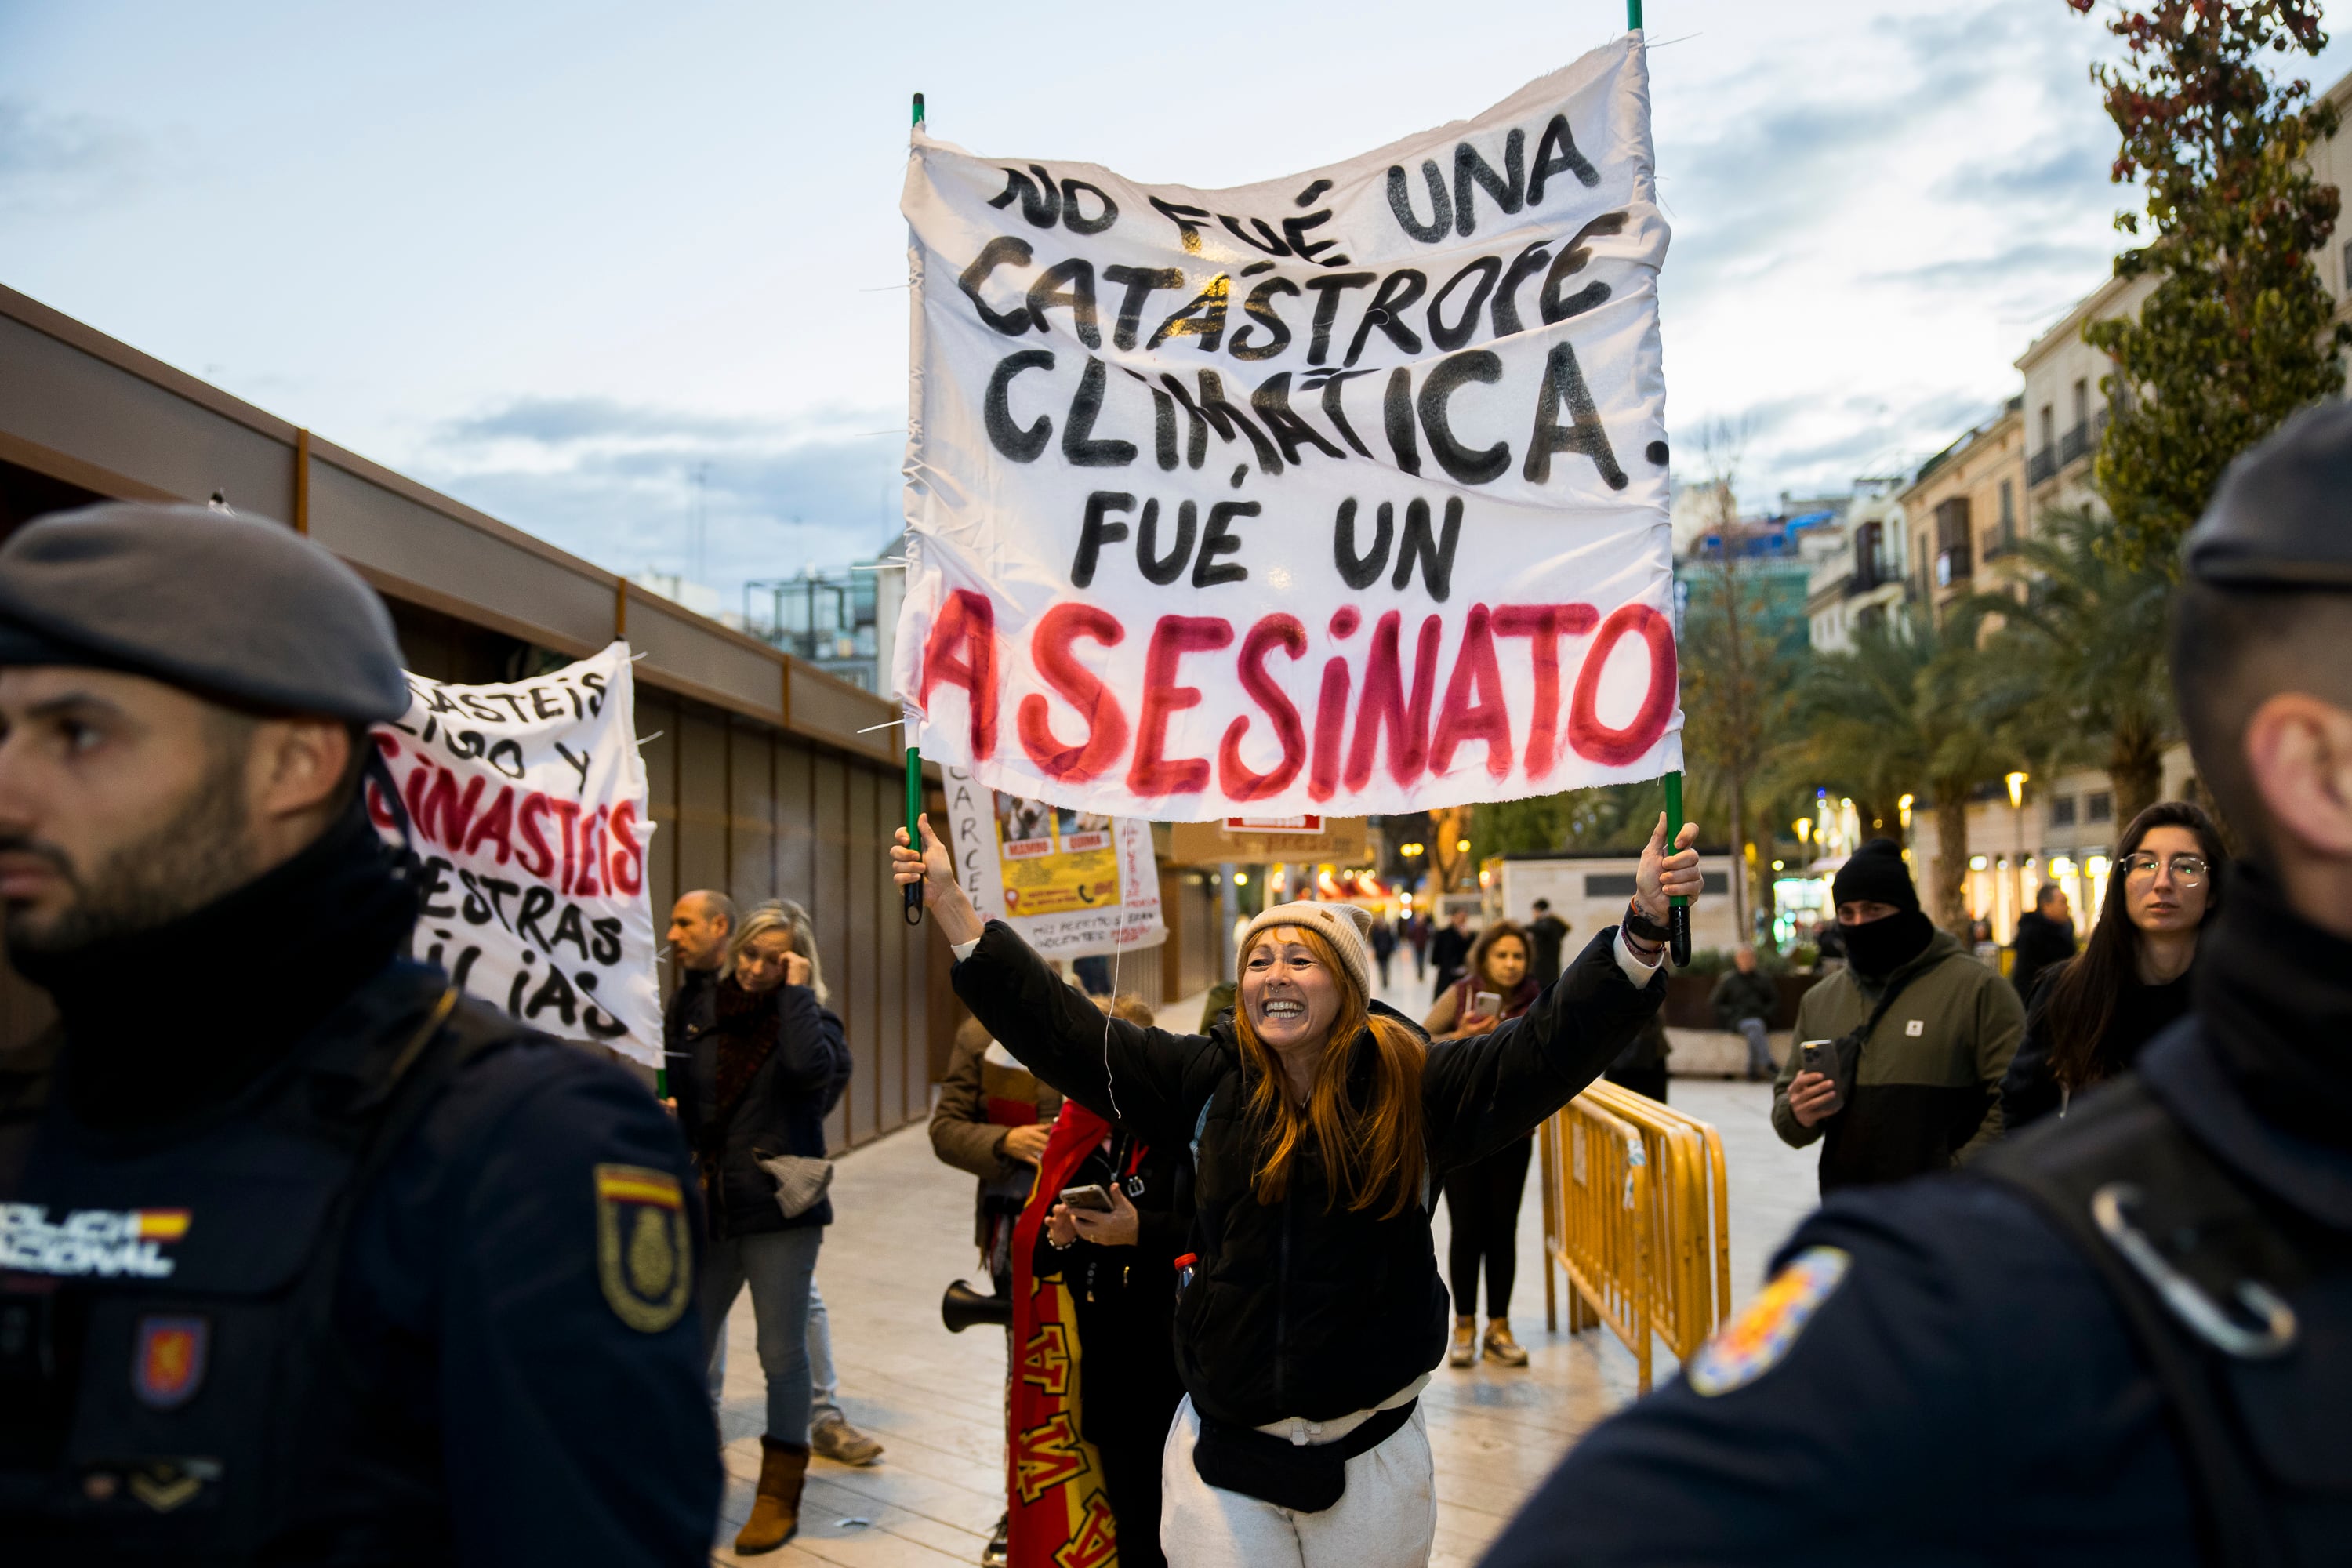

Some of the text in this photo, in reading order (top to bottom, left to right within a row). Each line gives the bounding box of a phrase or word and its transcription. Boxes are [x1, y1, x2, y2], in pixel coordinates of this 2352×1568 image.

[987, 164, 1119, 235] NO
[1387, 114, 1601, 243] UNA
[1070, 464, 1464, 603] FUÉ UN
[554, 742, 590, 795] Y
[419, 855, 622, 966] ESTRAS
